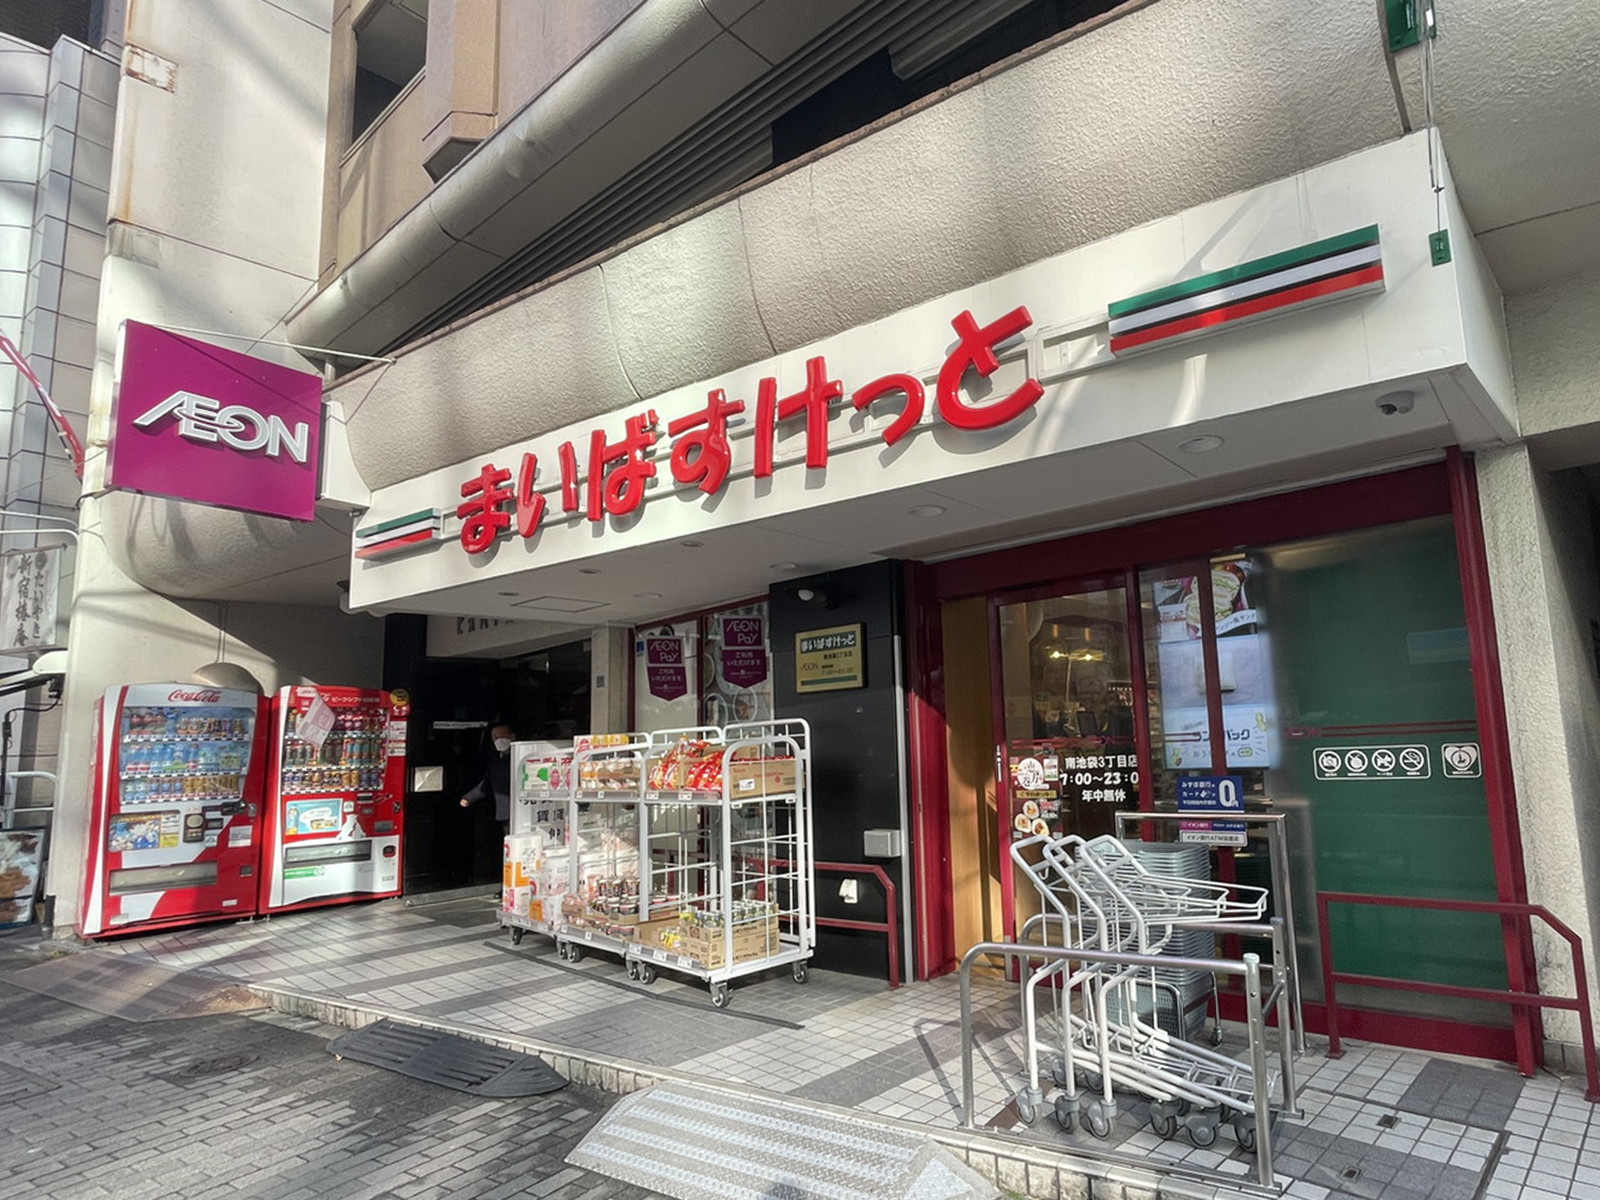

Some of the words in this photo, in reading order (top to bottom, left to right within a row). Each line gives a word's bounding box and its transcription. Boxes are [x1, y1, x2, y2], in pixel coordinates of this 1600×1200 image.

[457, 305, 1045, 555] まいばすけっと
[737, 633, 759, 645] Pay
[801, 633, 856, 653] まいばすけっと
[659, 652, 679, 662] Pay
[167, 689, 224, 704] Coca-Cola
[1065, 754, 1138, 770] 南池袋3丁目店
[1082, 789, 1127, 803] 年中無休
